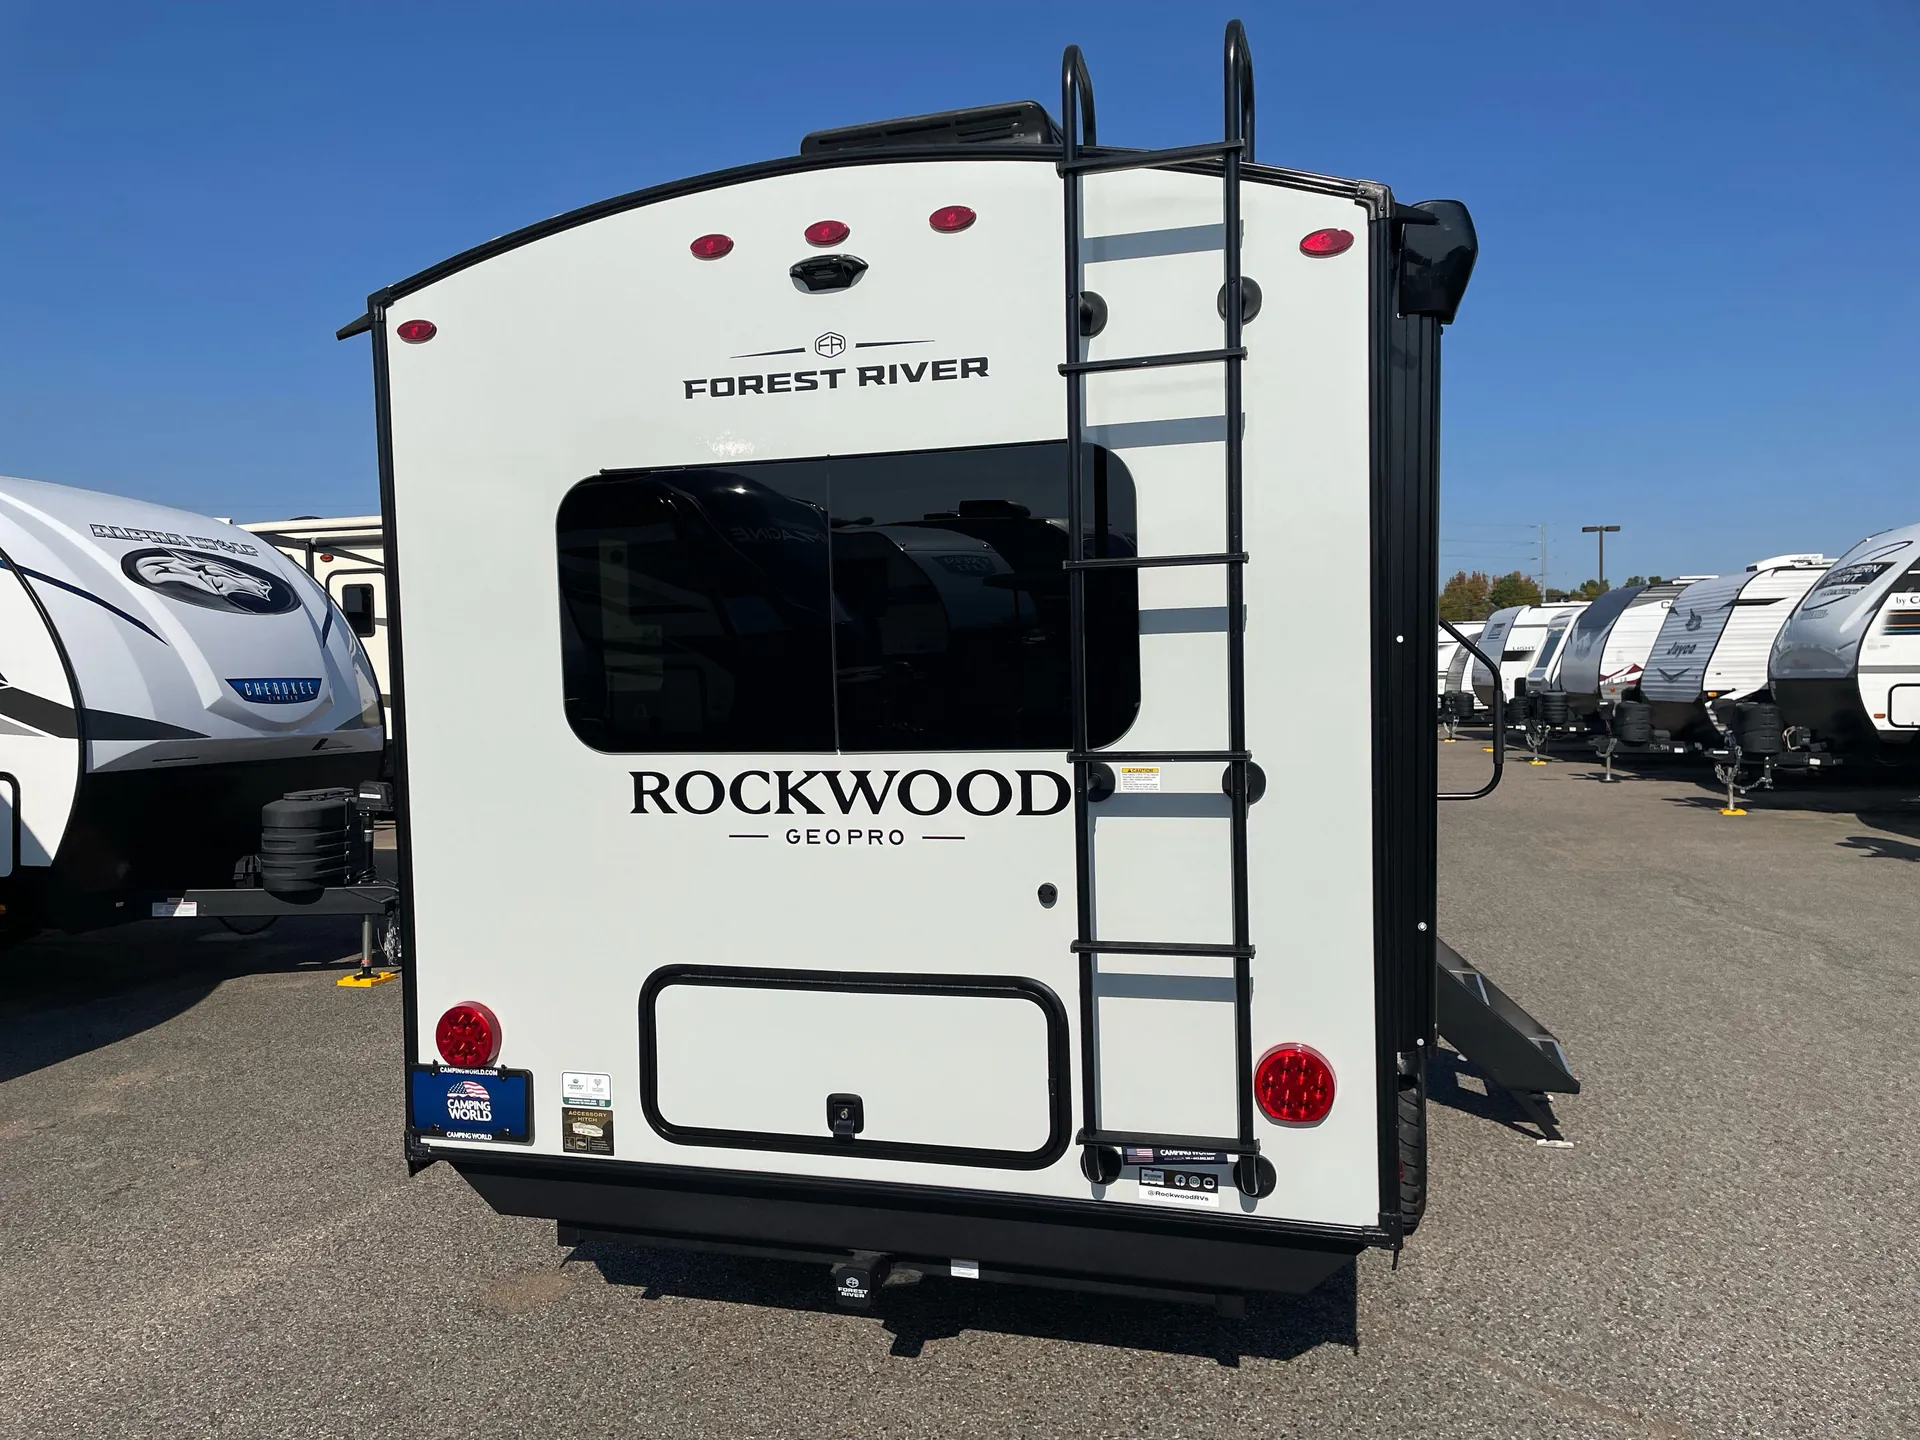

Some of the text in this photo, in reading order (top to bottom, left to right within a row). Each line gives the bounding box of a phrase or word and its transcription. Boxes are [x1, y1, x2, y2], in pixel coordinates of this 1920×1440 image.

[682, 356, 990, 400] FOREST RIVER
[89, 524, 258, 557] ALPHA WOLF
[1896, 595, 1920, 606] by C
[1666, 641, 1697, 658] Jayco
[244, 682, 314, 696] CHEROKEE
[628, 769, 1071, 815] ROCKWOOD
[786, 828, 905, 845] GEOPRO
[440, 1066, 498, 1076] CAMPINGWORLD.COM
[447, 1098, 491, 1111] CAMPING
[448, 1108, 492, 1121] WORLD
[568, 1110, 608, 1118] ACCESSORY
[446, 1131, 493, 1140] CAMPING WORLD
[1147, 1190, 1209, 1202] @RockwoodRVs
